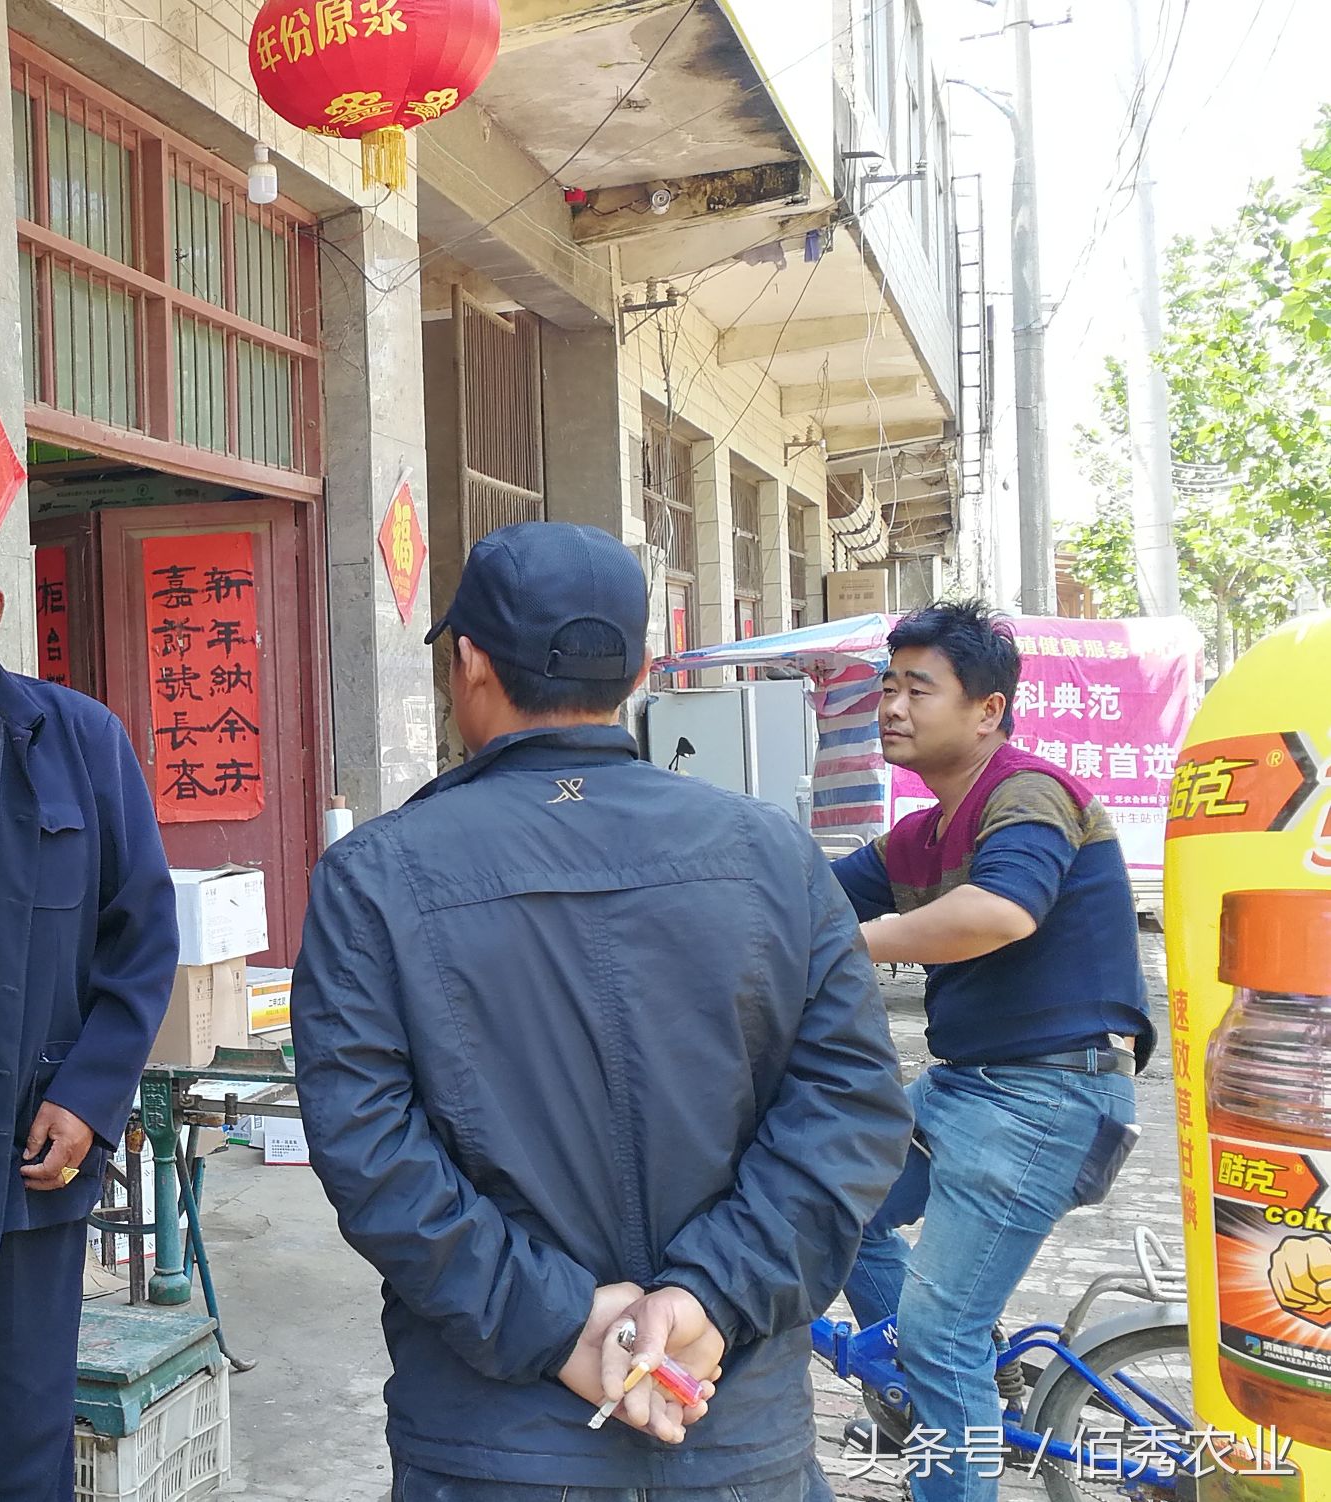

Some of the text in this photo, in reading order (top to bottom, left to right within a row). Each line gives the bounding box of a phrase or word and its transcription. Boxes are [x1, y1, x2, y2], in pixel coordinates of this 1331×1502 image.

[257, 0, 408, 73] 年份原浆
[392, 499, 414, 577] 福
[1218, 1150, 1289, 1198] 酷克
